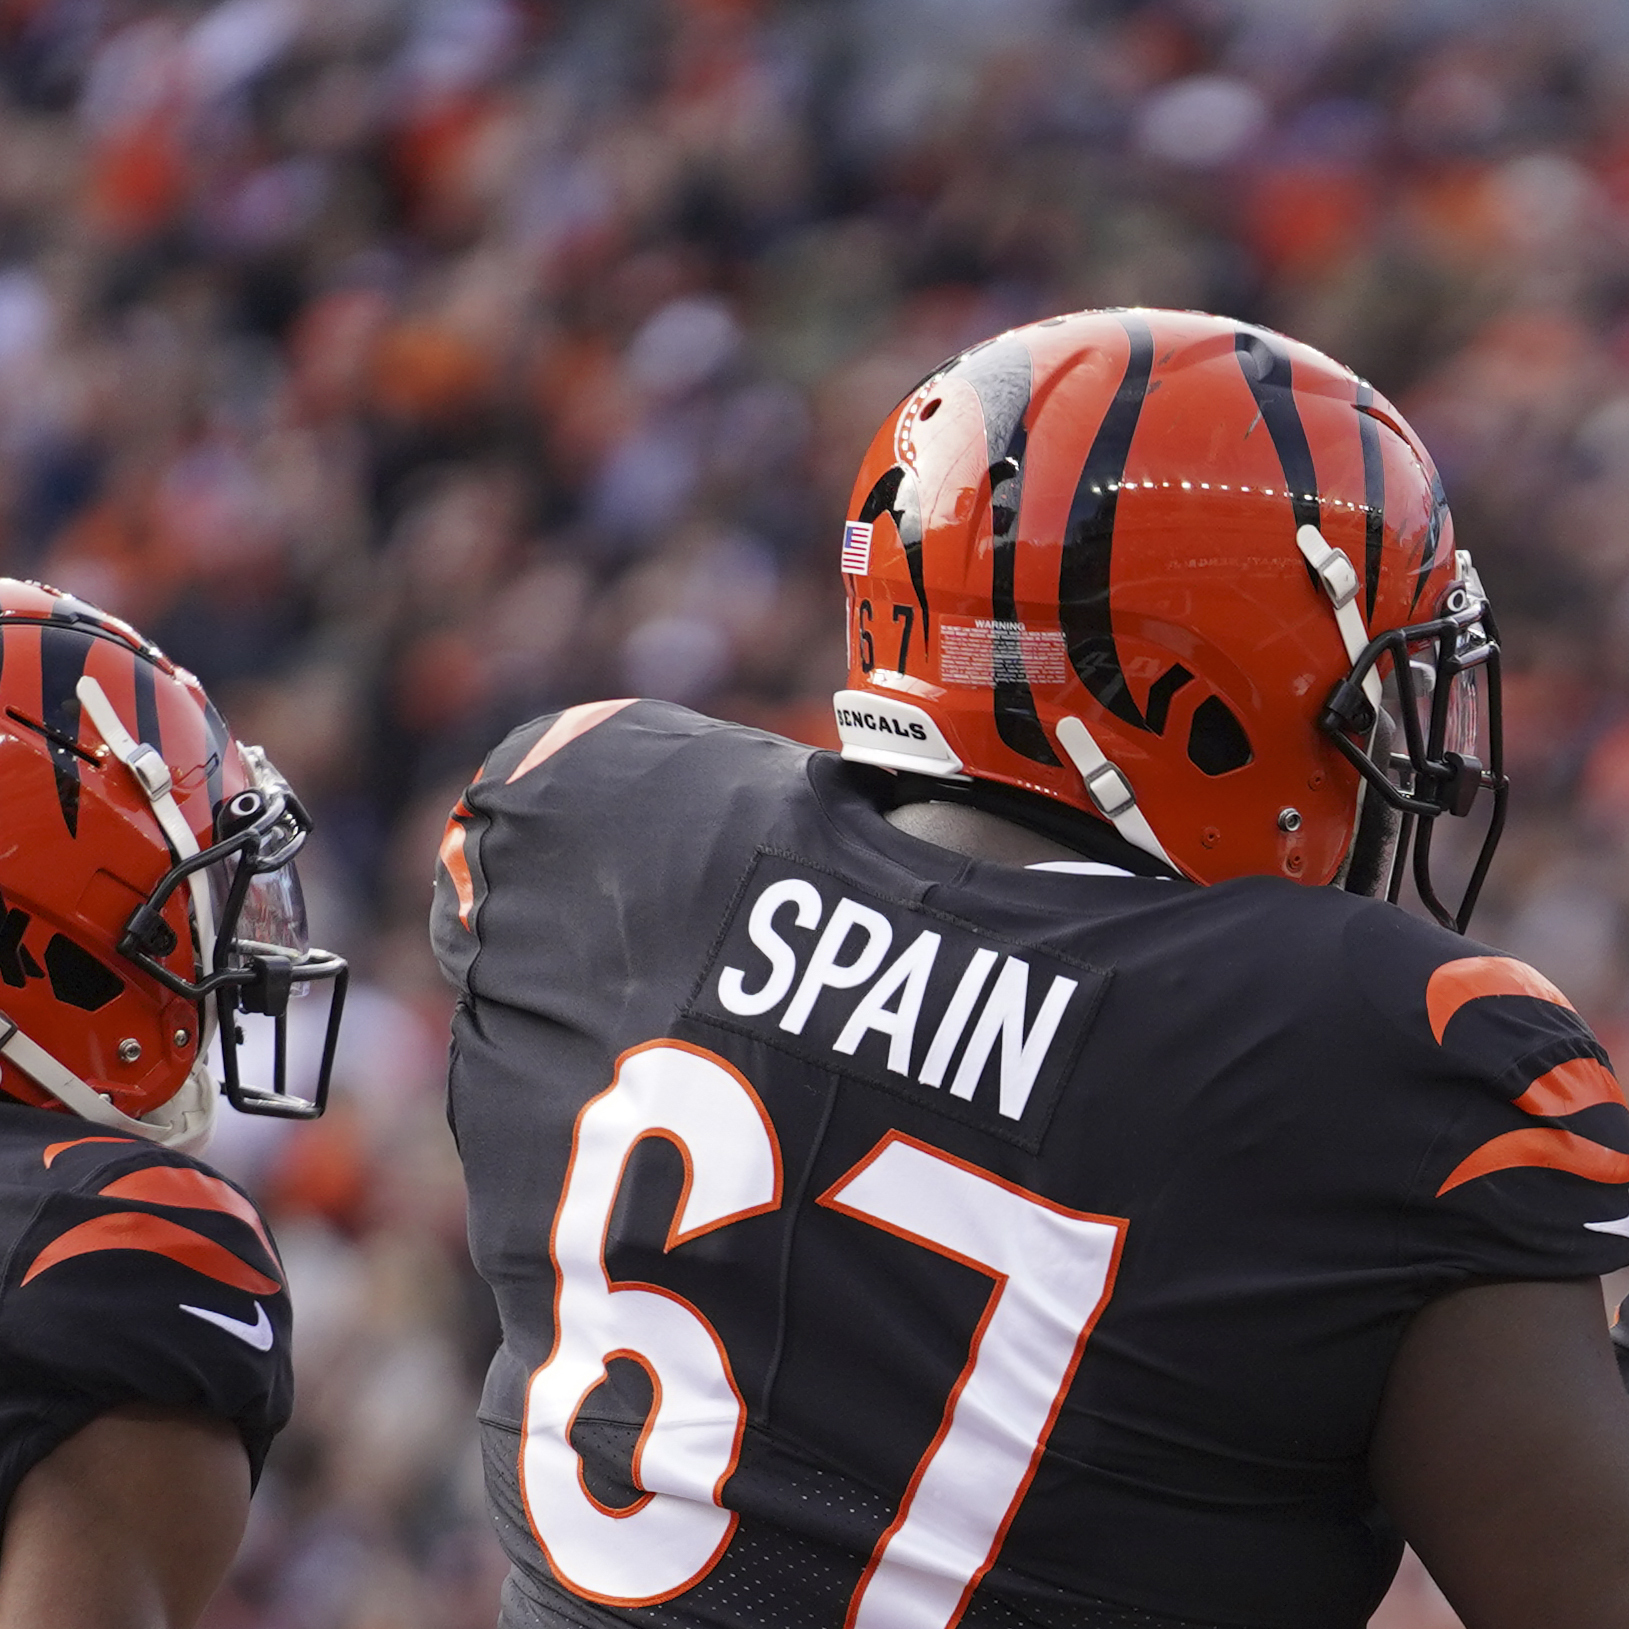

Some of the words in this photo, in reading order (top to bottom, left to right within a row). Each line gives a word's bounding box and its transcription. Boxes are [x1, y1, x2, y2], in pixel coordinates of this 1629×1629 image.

[975, 619, 1026, 632] WARNING
[837, 709, 927, 741] BENGALS
[717, 879, 1078, 1121] SPAIN
